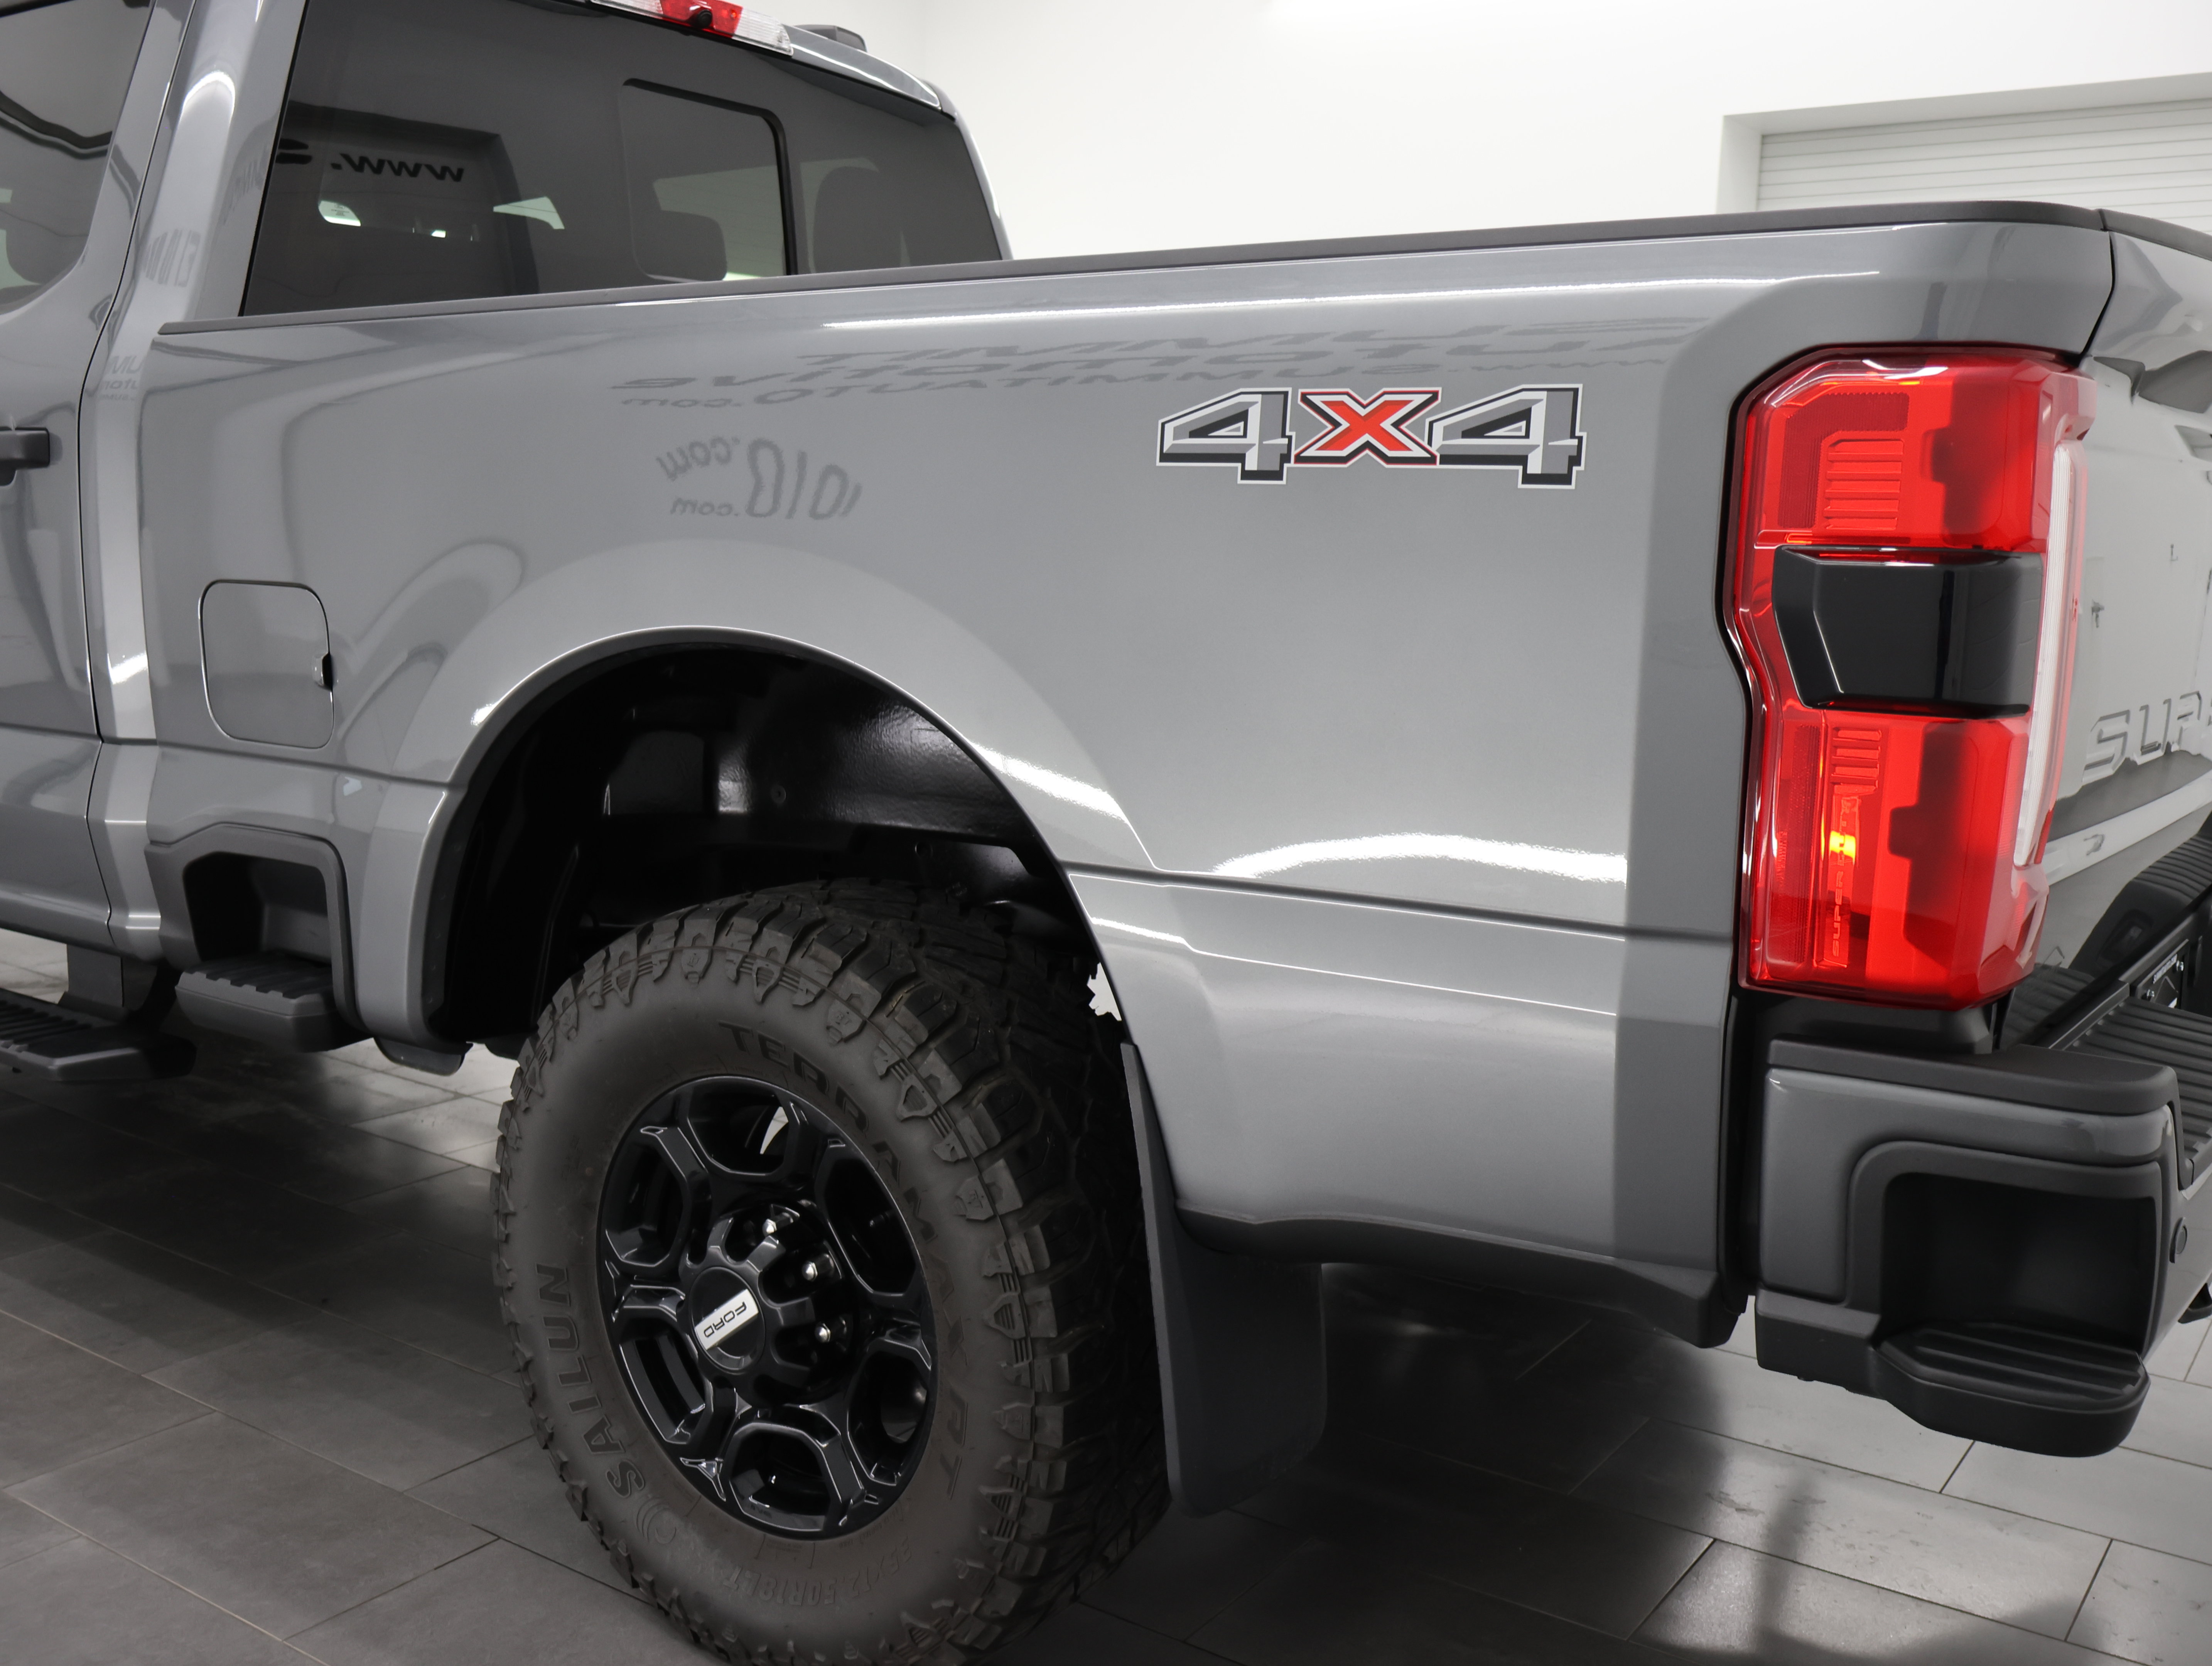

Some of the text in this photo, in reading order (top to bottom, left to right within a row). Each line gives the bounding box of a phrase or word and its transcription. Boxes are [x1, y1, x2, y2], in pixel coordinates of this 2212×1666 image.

[2082, 690, 2212, 784] SUP
[1832, 870, 1844, 957] SUPER
[704, 1301, 747, 1338] FORD
[535, 1263, 645, 1499] SAILUN
